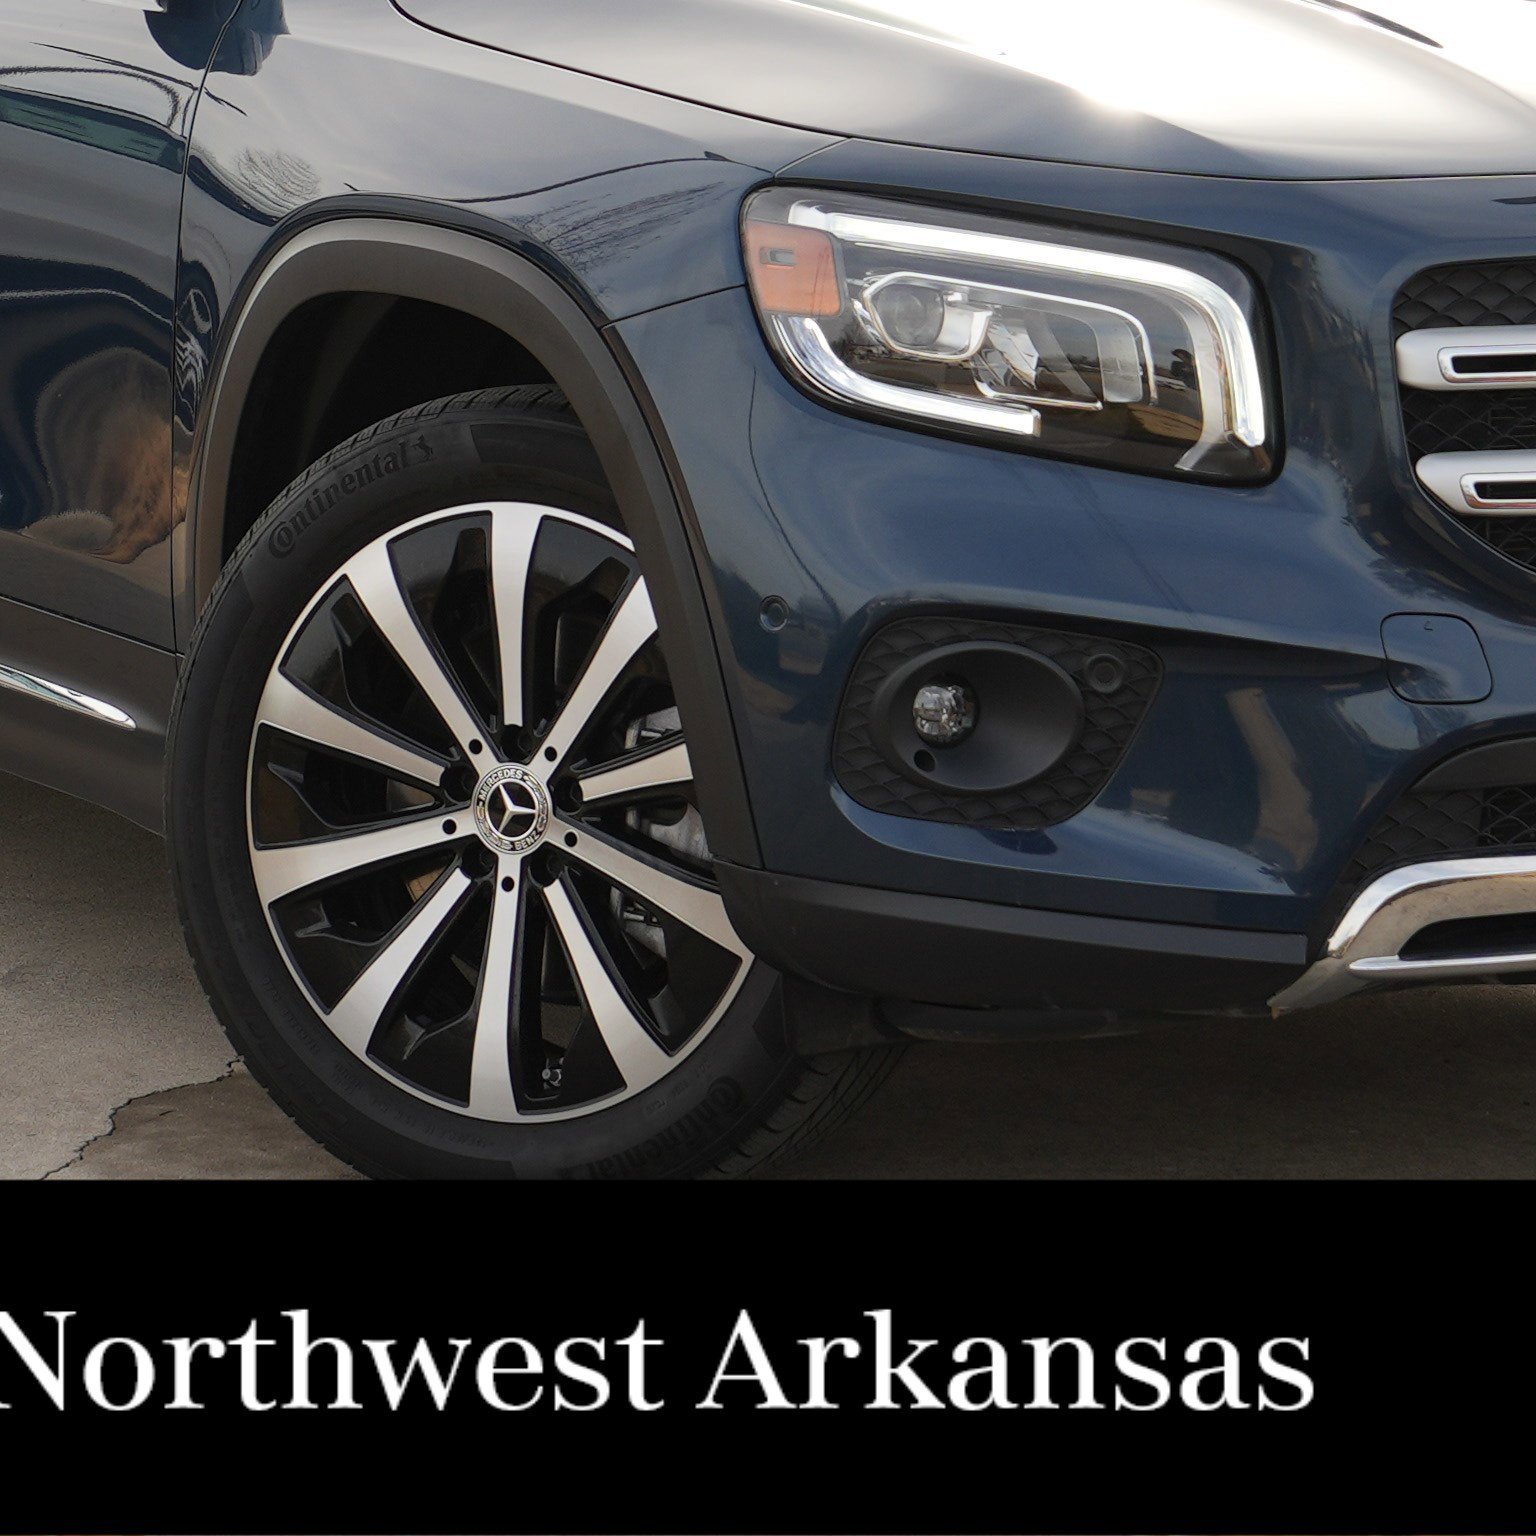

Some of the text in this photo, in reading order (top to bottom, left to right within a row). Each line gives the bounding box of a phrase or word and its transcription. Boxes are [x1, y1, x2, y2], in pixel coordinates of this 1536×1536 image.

[268, 432, 410, 559] Continental
[478, 768, 524, 801] MERCEDES
[514, 829, 541, 851] BENZ
